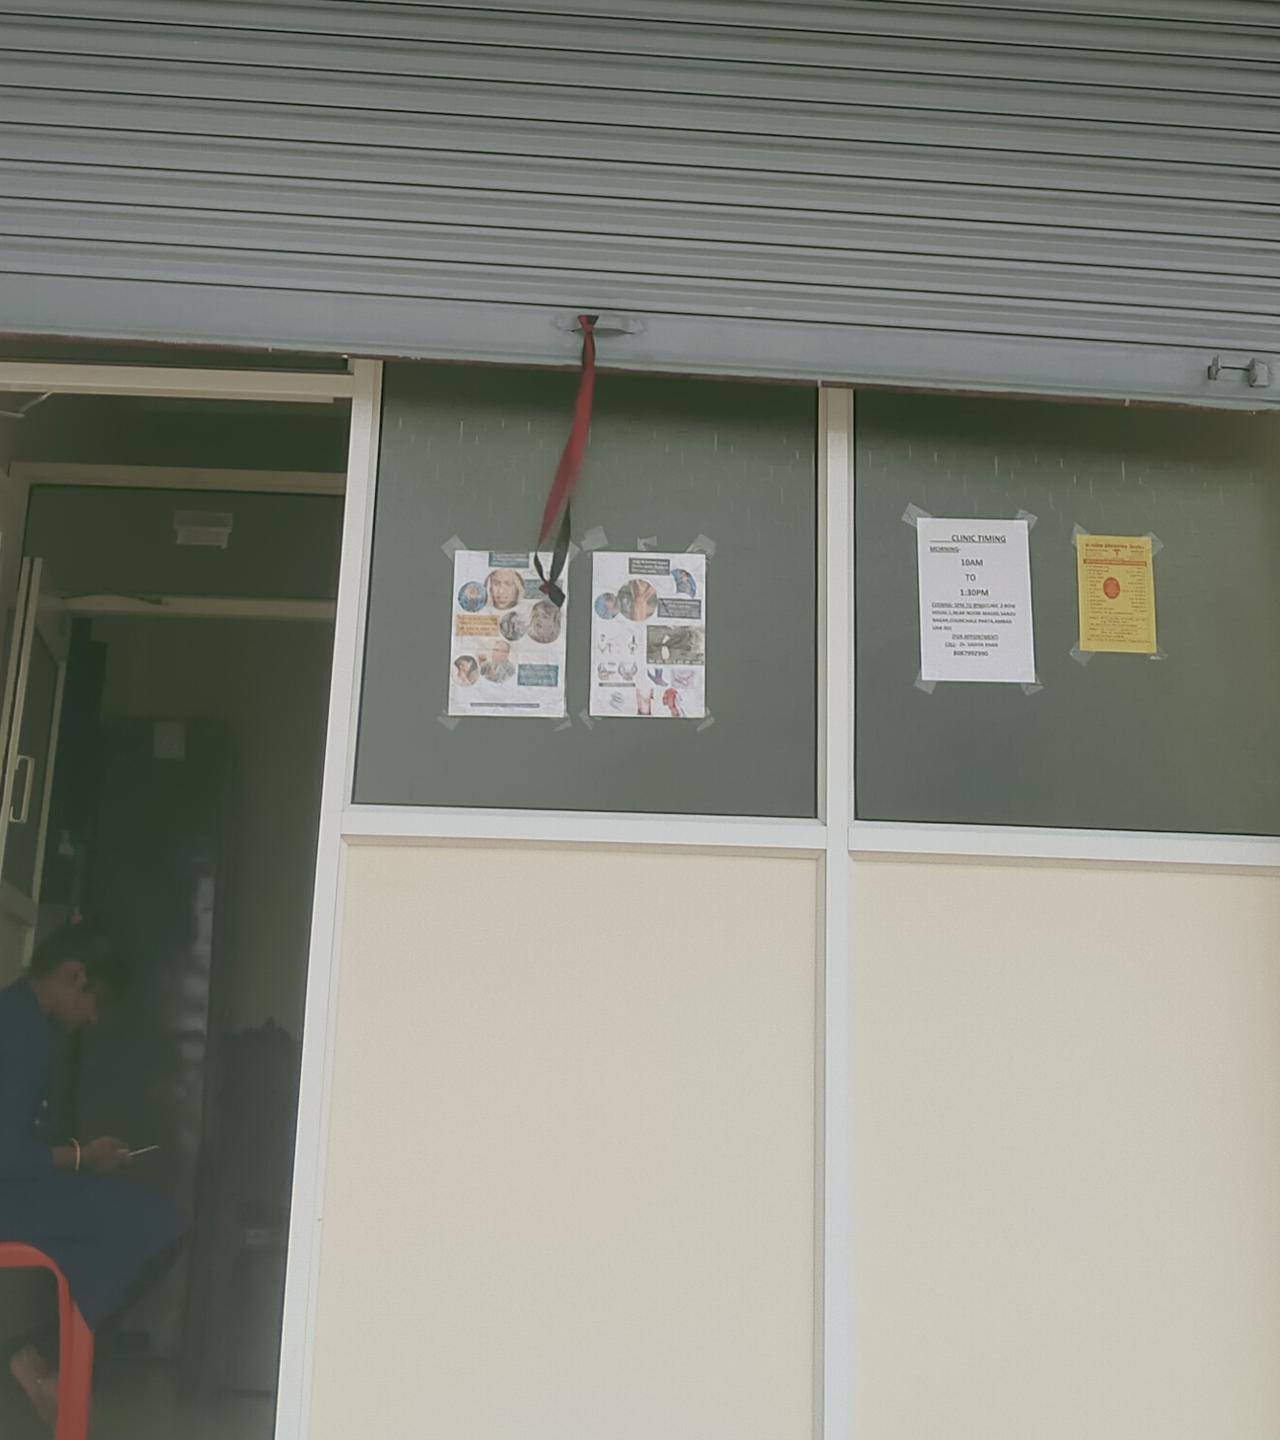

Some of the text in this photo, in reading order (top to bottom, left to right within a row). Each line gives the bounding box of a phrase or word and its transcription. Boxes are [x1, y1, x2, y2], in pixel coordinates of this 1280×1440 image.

[951, 534, 1007, 544] CLINIC TIMING
[960, 558, 984, 567] 10AM
[965, 573, 976, 581] TO
[959, 588, 989, 597] 1:30PM
